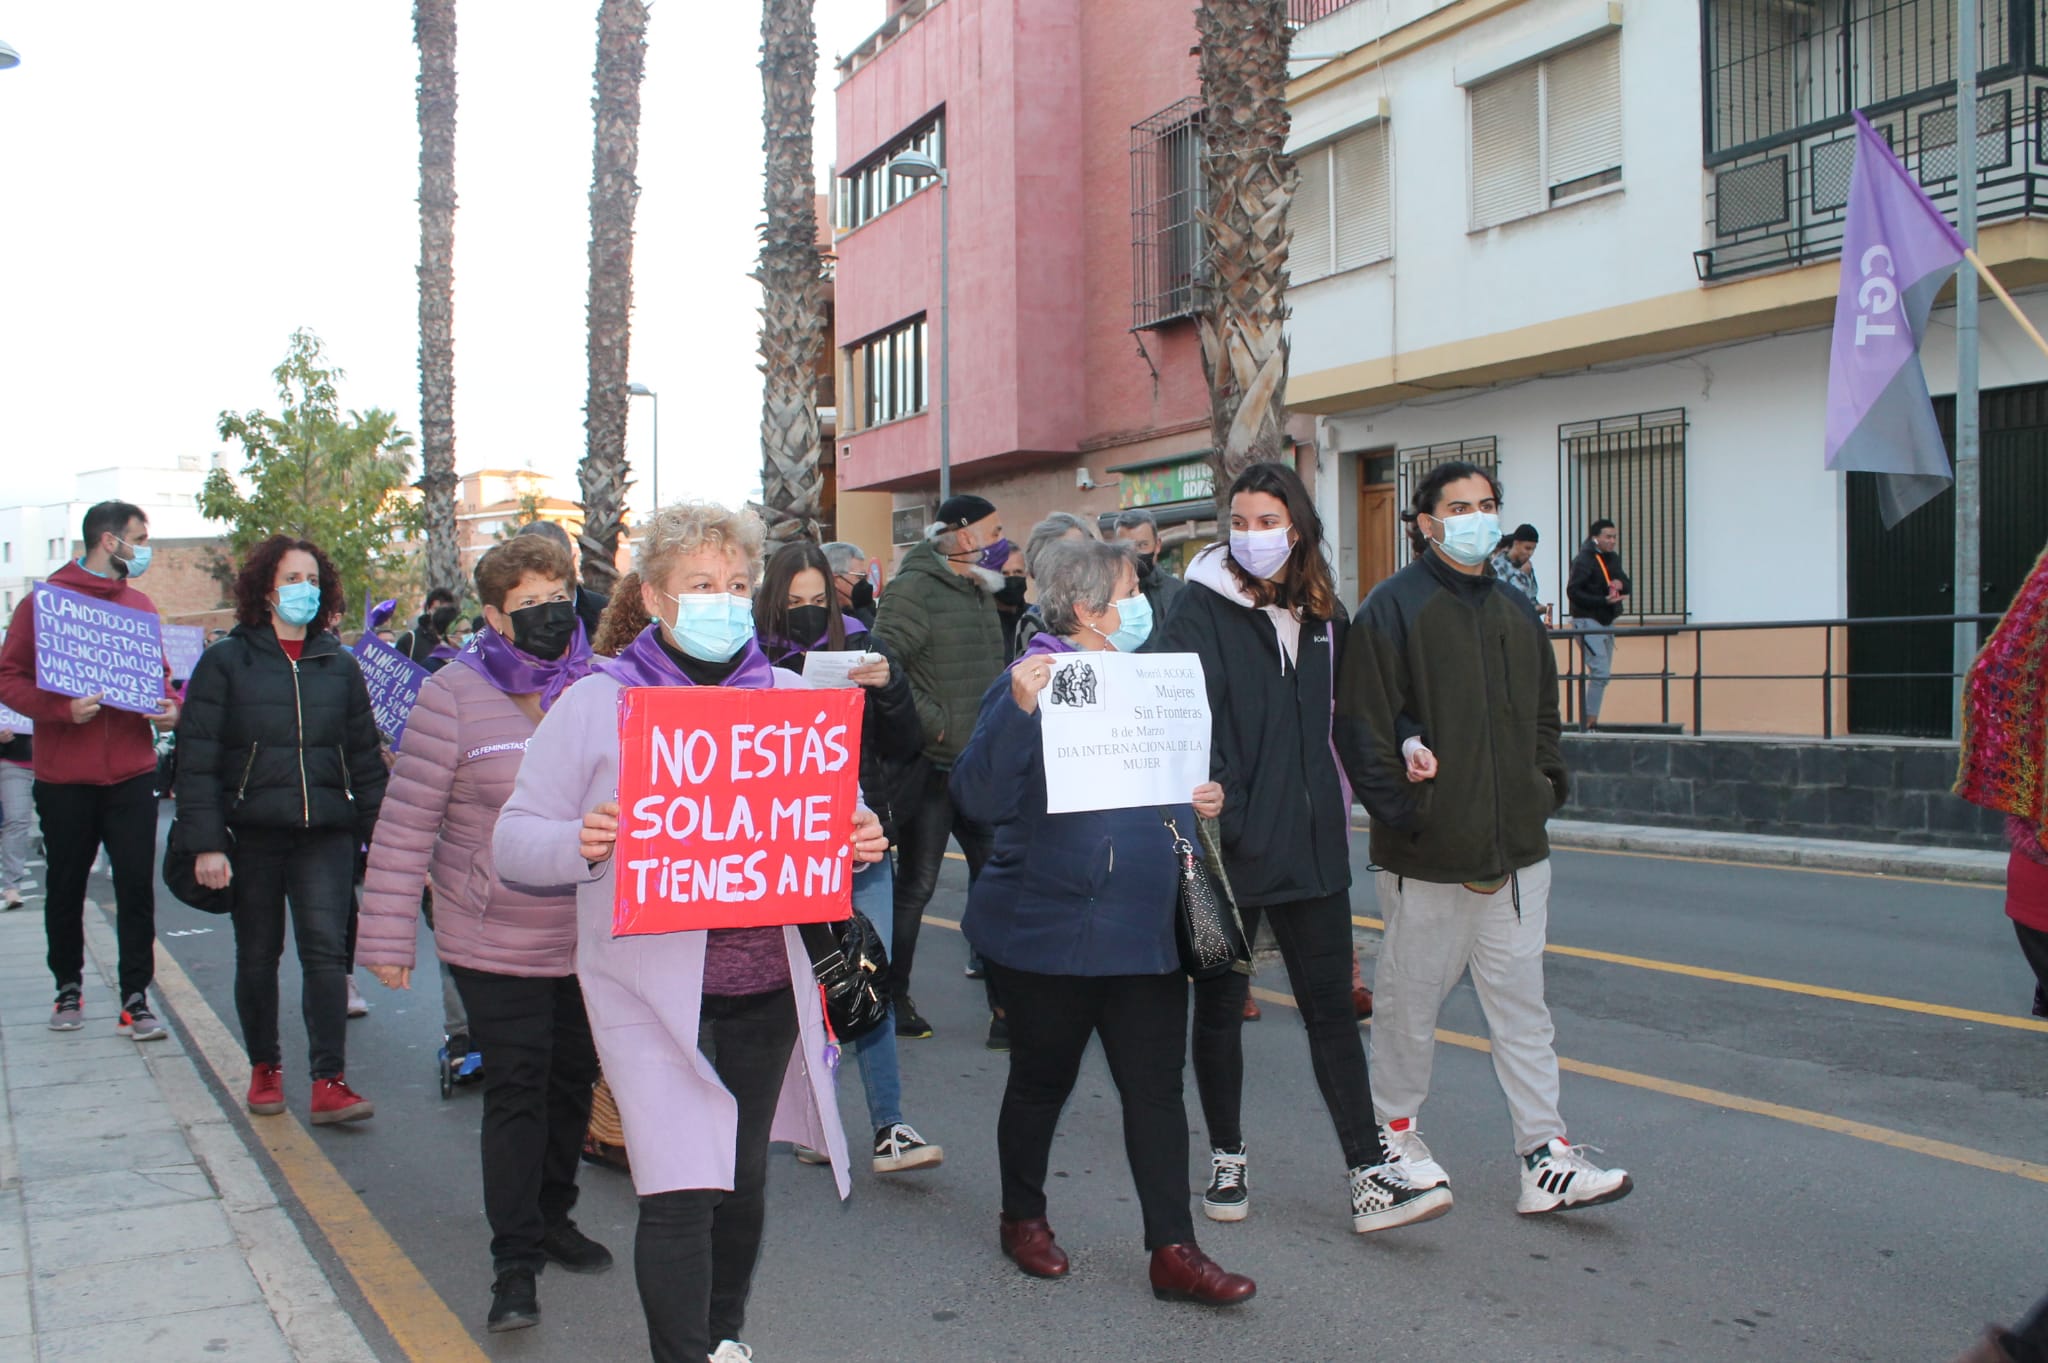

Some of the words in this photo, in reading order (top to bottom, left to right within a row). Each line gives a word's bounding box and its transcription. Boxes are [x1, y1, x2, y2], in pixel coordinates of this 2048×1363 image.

[40, 613, 101, 644] MUNDO
[137, 621, 156, 640] EL
[38, 651, 74, 676] UNA
[140, 676, 160, 694] SE
[1163, 668, 1196, 679] ACOGE
[40, 669, 97, 697] VUELVE
[391, 681, 406, 699] TE
[1155, 685, 1196, 702] Mujeres
[1134, 705, 1154, 720] Sin
[1156, 705, 1203, 720] Fronteras
[1111, 727, 1119, 738] 8
[1121, 726, 1134, 738] de
[1136, 725, 1165, 737] Marzo
[467, 748, 480, 759] LAS
[480, 742, 525, 755] FEMINISTAS
[652, 726, 718, 787] NO
[731, 711, 849, 783] ESTÁS
[1082, 741, 1177, 757] INTERNACIONAL
[1177, 740, 1189, 752] DE
[1189, 740, 1203, 752] LA
[1123, 757, 1161, 770] MUJER
[630, 795, 764, 842] SOLA,
[770, 795, 832, 841] ME
[776, 854, 799, 895] A
